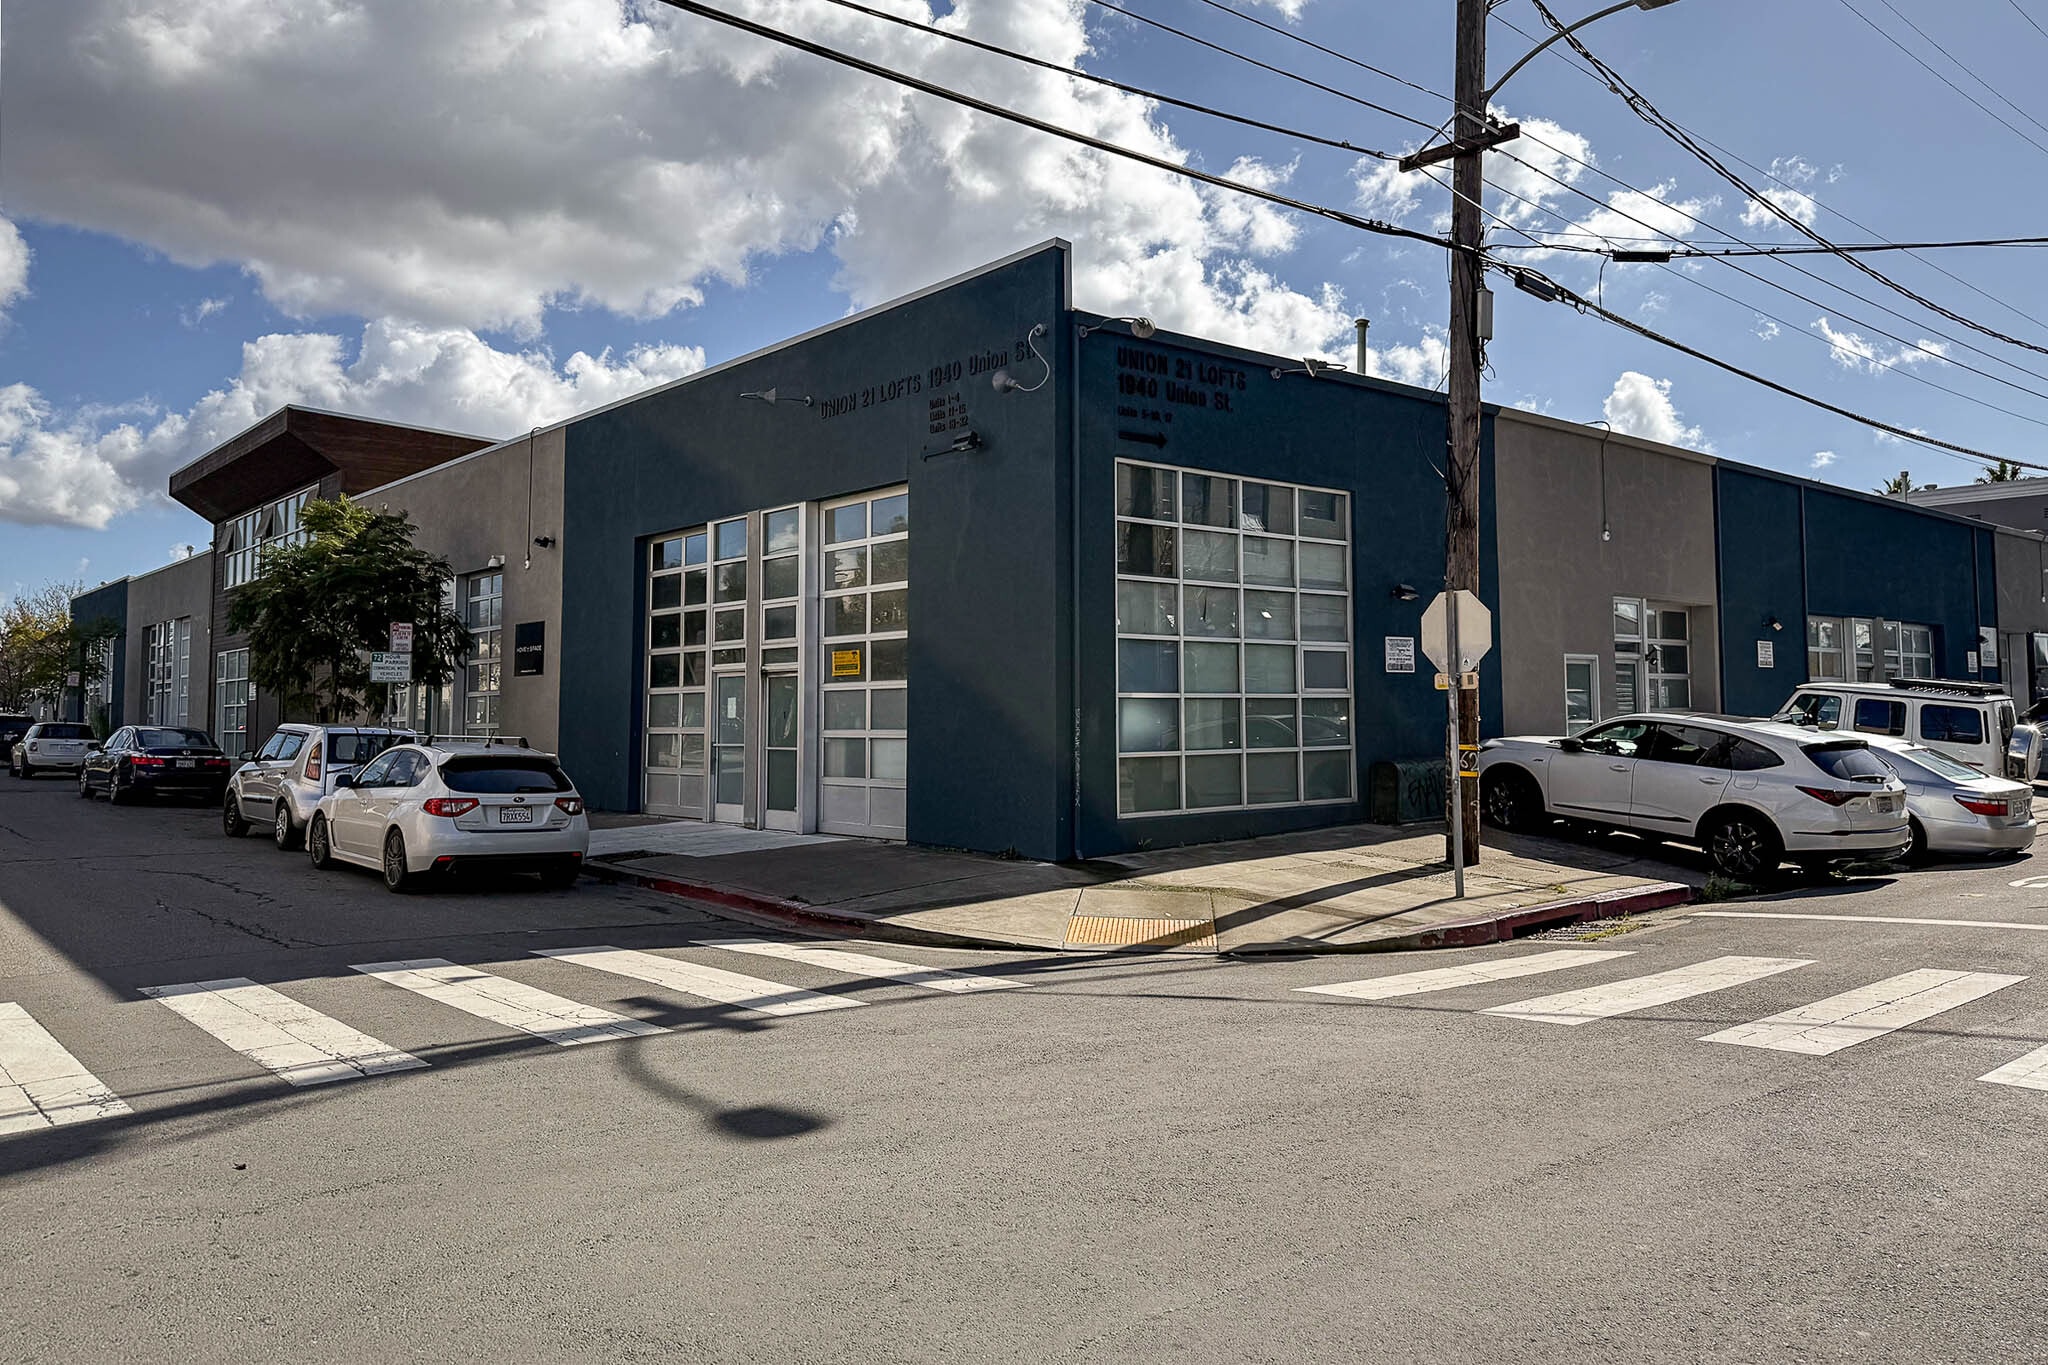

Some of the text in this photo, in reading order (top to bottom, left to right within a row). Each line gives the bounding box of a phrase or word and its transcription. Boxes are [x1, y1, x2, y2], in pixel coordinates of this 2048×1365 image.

[1118, 346, 1247, 390] UNION 21 LOFTS
[820, 392, 857, 420] UNION
[862, 386, 875, 408] 21
[879, 374, 921, 403] LOFTS
[929, 361, 961, 388] 1940
[969, 349, 1008, 376] Union
[1118, 373, 1233, 412] 1940 Union St.
[930, 398, 945, 409] Units
[929, 409, 946, 422] Units
[929, 421, 946, 434] Units
[373, 654, 383, 662] 72
[1459, 751, 1479, 772] 62
